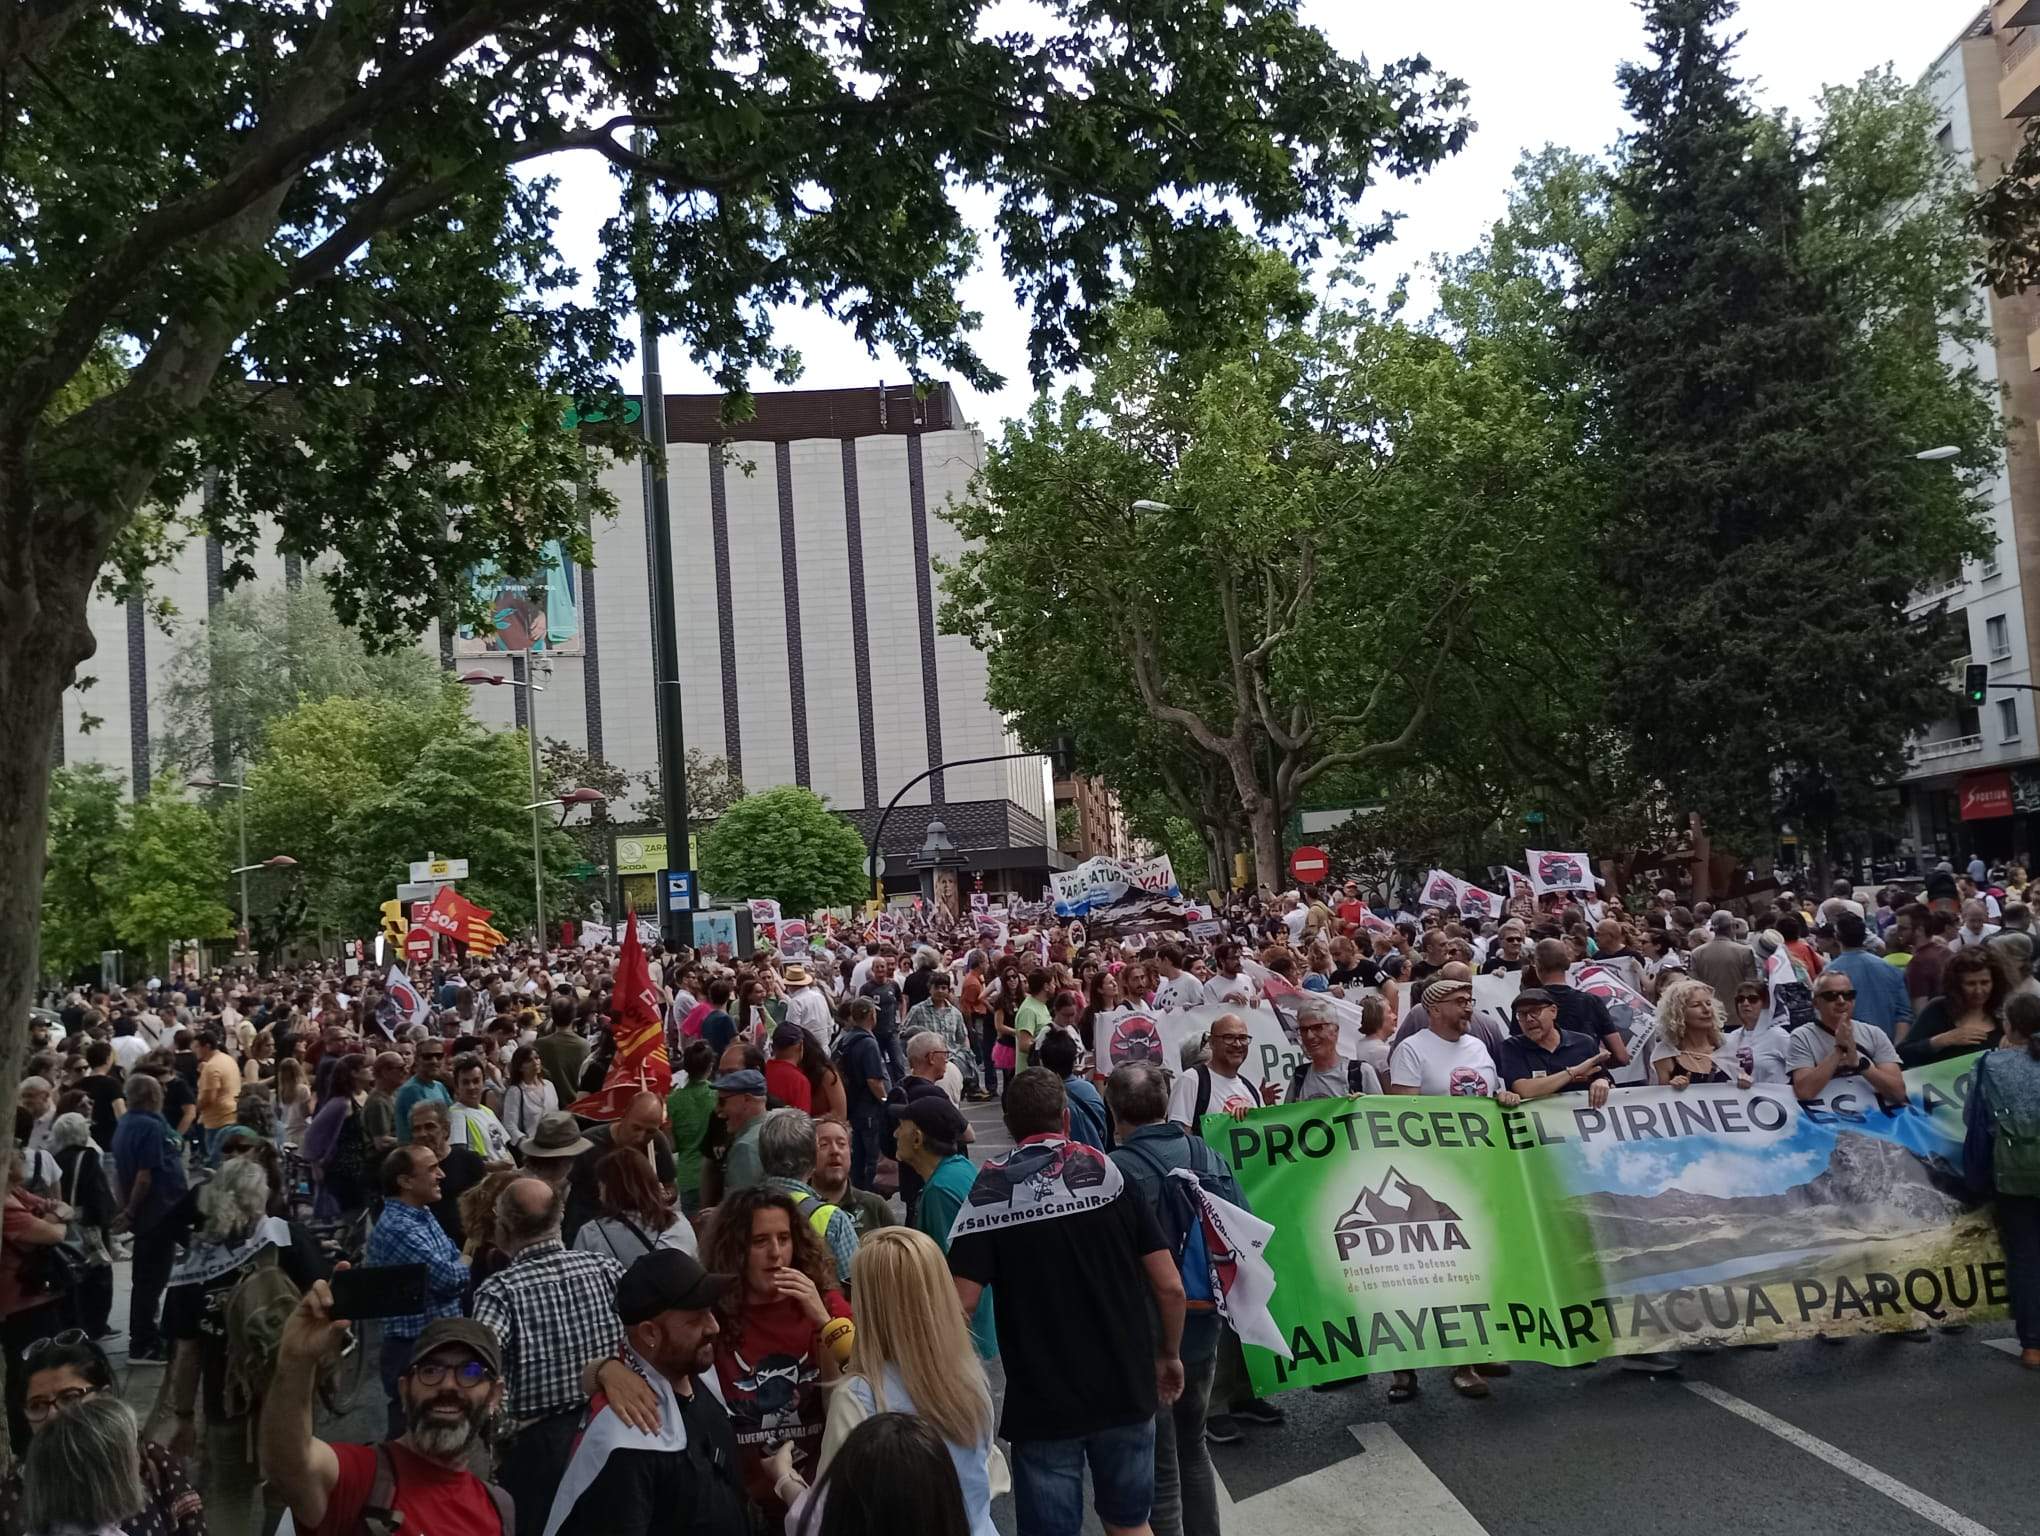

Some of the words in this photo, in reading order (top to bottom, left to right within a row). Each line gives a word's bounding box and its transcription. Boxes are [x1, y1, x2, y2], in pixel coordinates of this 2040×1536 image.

[429, 909, 459, 932] SOA
[1228, 1110, 1496, 1171] PROTEGER
[1501, 1111, 1567, 1151] EL
[1573, 1094, 1789, 1143] PIRINEO
[1797, 1093, 1867, 1124] ES
[1334, 1222, 1472, 1262] PDMA
[1343, 1263, 1400, 1278] Plataforma
[1403, 1261, 1416, 1271] en
[1417, 1258, 1457, 1270] Defensa
[1347, 1283, 1360, 1294] de
[1362, 1280, 1378, 1291] las
[1381, 1273, 1430, 1289] montañas
[1432, 1272, 1445, 1284] de
[1792, 1261, 2007, 1322] PARQUE
